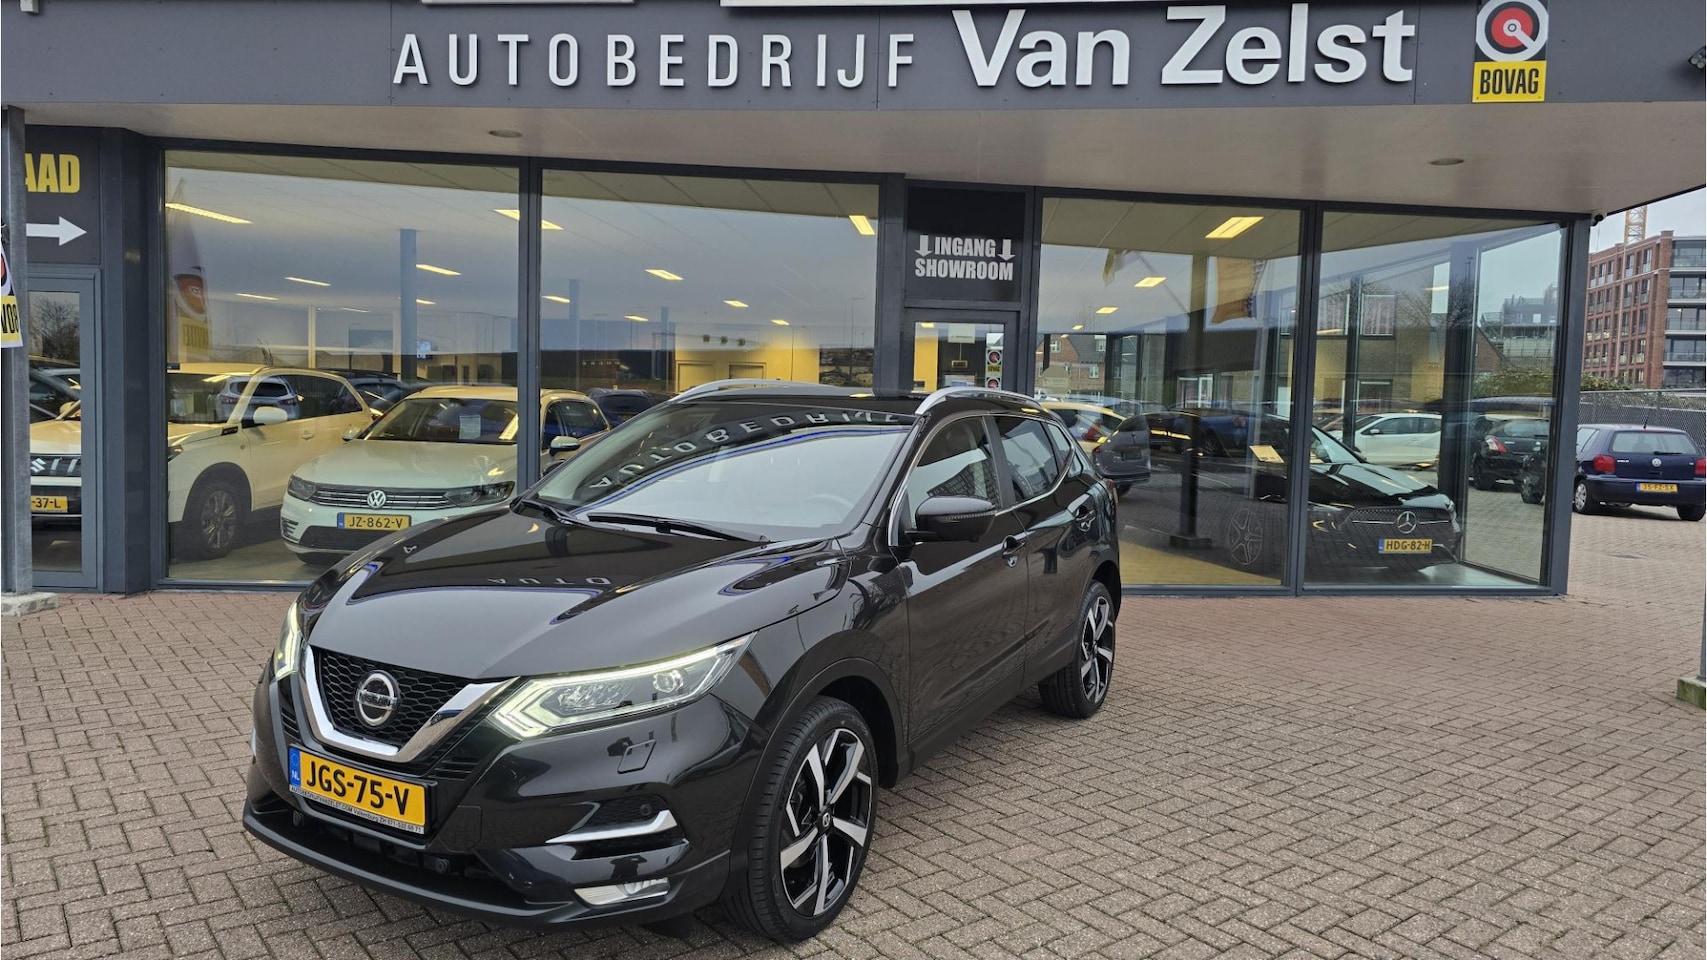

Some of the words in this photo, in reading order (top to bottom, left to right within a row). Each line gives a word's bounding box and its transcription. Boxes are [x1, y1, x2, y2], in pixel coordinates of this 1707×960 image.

[392, 33, 915, 88] AUTOBEDRIJF
[951, 9, 1131, 87] Van
[1161, 3, 1417, 86] Zelst
[1480, 68, 1540, 95] BOVAG
[934, 236, 997, 258] INGANG
[915, 258, 1014, 281] SHOWROOM
[349, 516, 403, 529] JZ-862-V
[1386, 540, 1431, 551] HDG-82-H
[291, 770, 300, 781] NL
[306, 760, 410, 816] JGS-75-V
